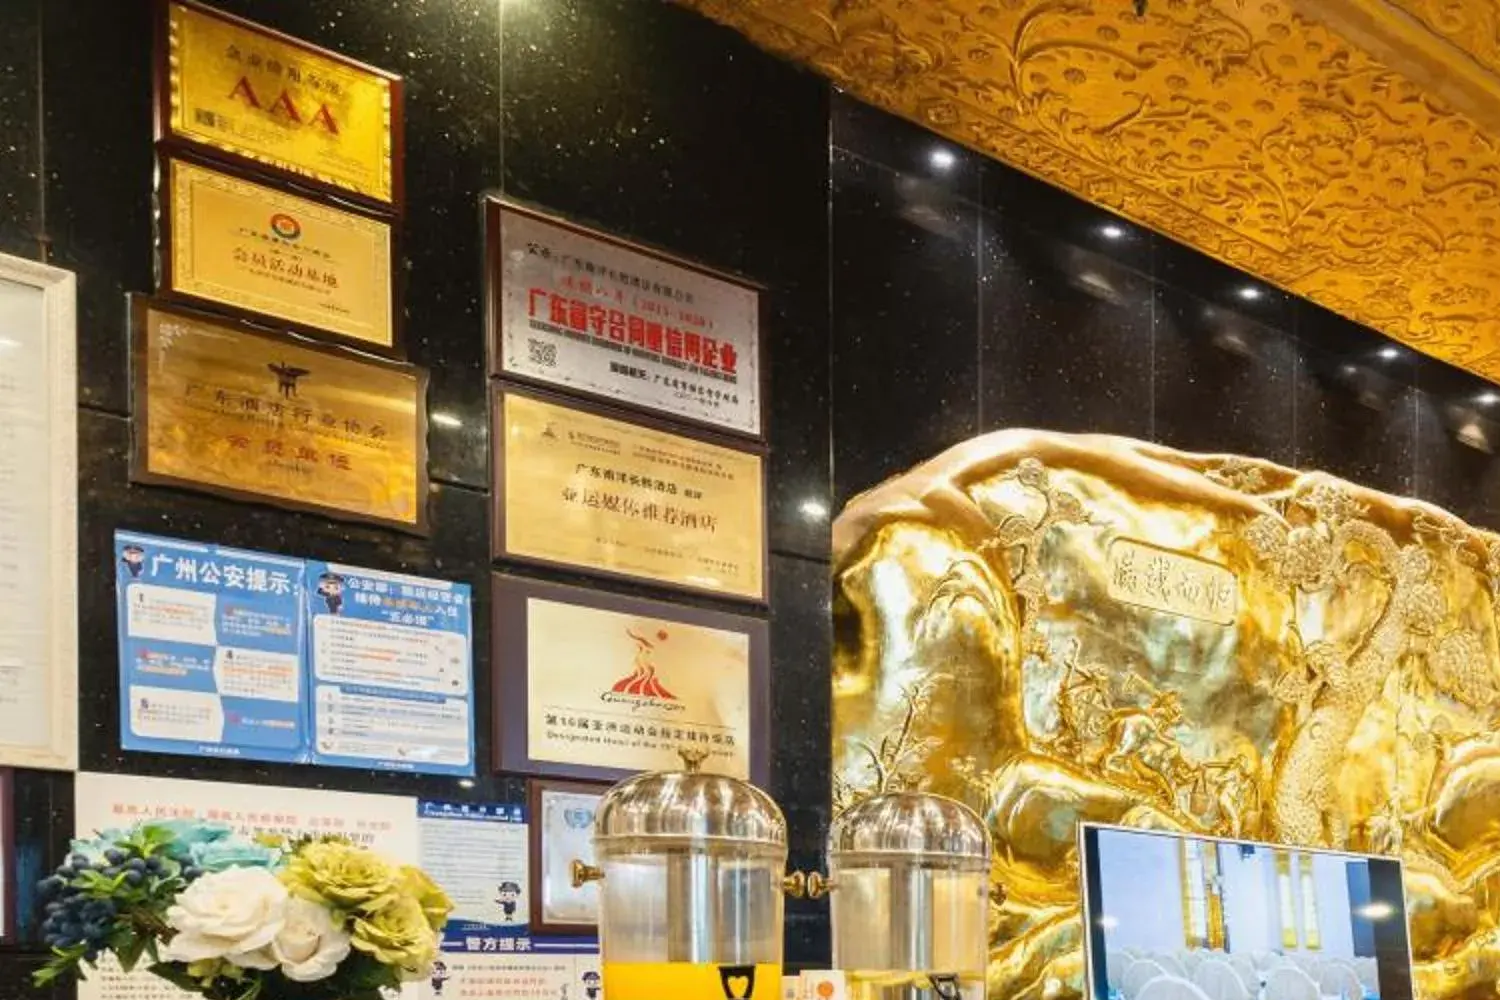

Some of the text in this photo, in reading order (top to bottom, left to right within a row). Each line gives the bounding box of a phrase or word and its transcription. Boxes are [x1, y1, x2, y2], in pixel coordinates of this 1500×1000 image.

[227, 75, 339, 135] AAA
[233, 247, 339, 288] 会员活动基地
[528, 287, 738, 375] 广东省守合同重信用企业
[186, 383, 386, 438] 广东酒店行业协会
[228, 433, 352, 471] 会员单位
[562, 487, 718, 534] 亚运媒体推荐酒店
[546, 731, 600, 745] Designated
[466, 936, 532, 951] 警方提示
